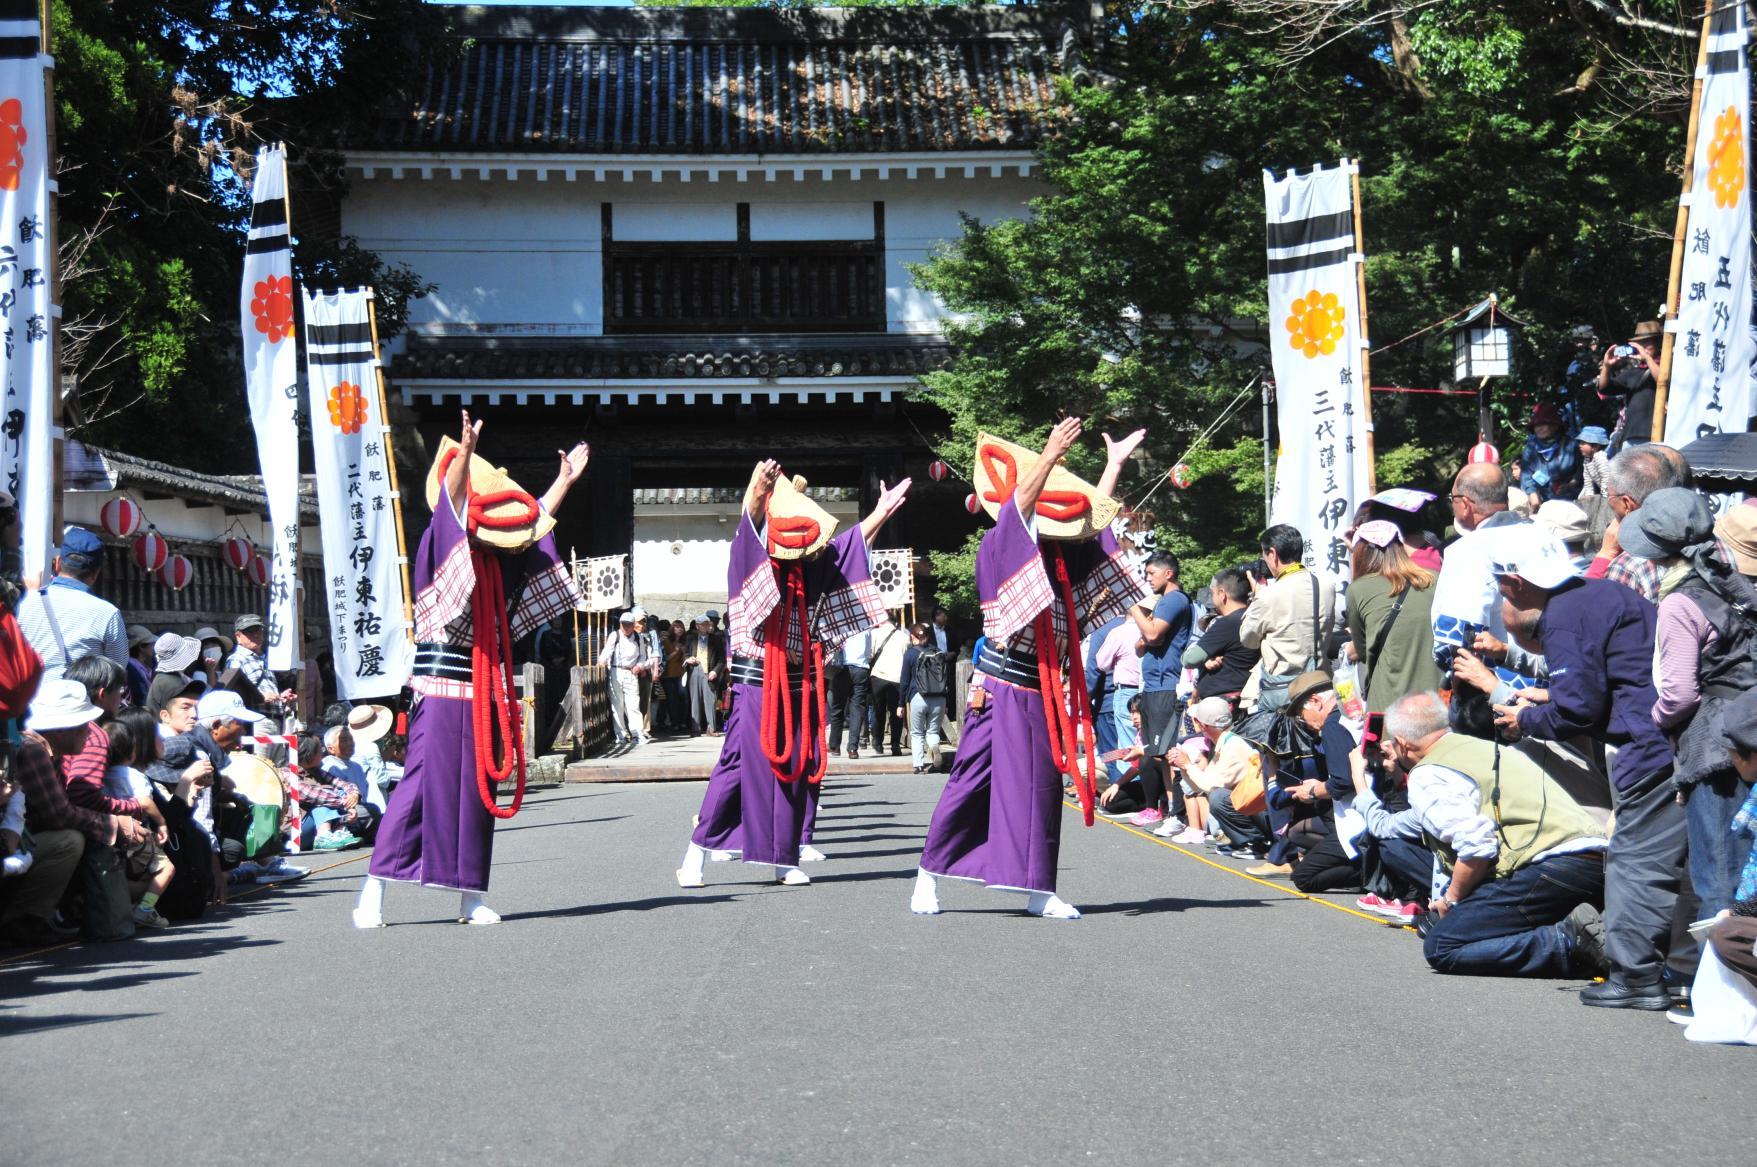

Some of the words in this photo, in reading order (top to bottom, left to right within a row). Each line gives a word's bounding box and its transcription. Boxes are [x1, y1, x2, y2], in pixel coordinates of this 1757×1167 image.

[18, 214, 48, 344] 飫肥藩
[364, 442, 386, 511] 飫肥藩
[1312, 389, 1351, 600] 三代藩主伊東
[347, 463, 386, 677] 二代藩主伊東祐慶
[1303, 538, 1317, 573] 飫肥
[333, 576, 347, 654] 飫肥城下まつり
